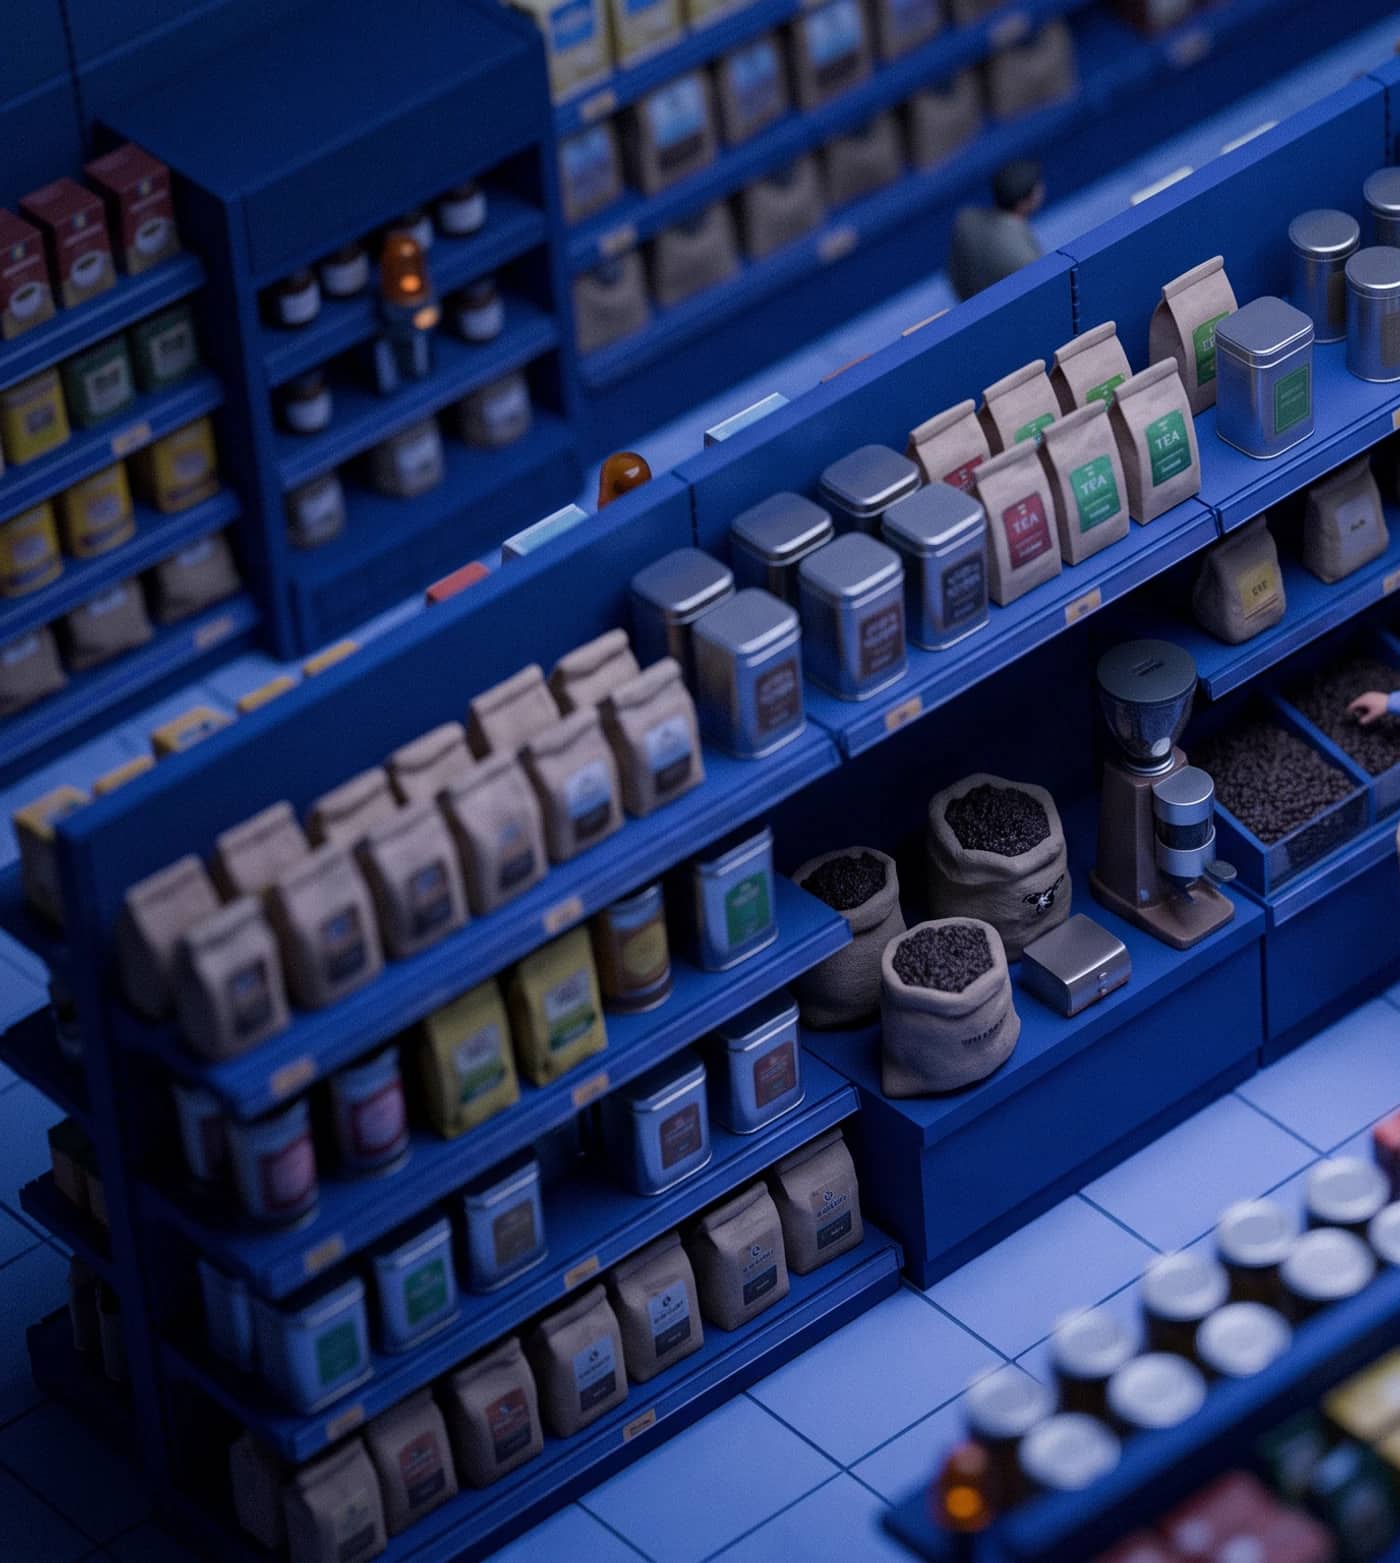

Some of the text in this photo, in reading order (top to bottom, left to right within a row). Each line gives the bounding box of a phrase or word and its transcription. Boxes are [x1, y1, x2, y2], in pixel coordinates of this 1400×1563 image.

[1154, 430, 1181, 449] TEA
[1080, 474, 1107, 496] TEA
[1012, 512, 1040, 533] TEA
